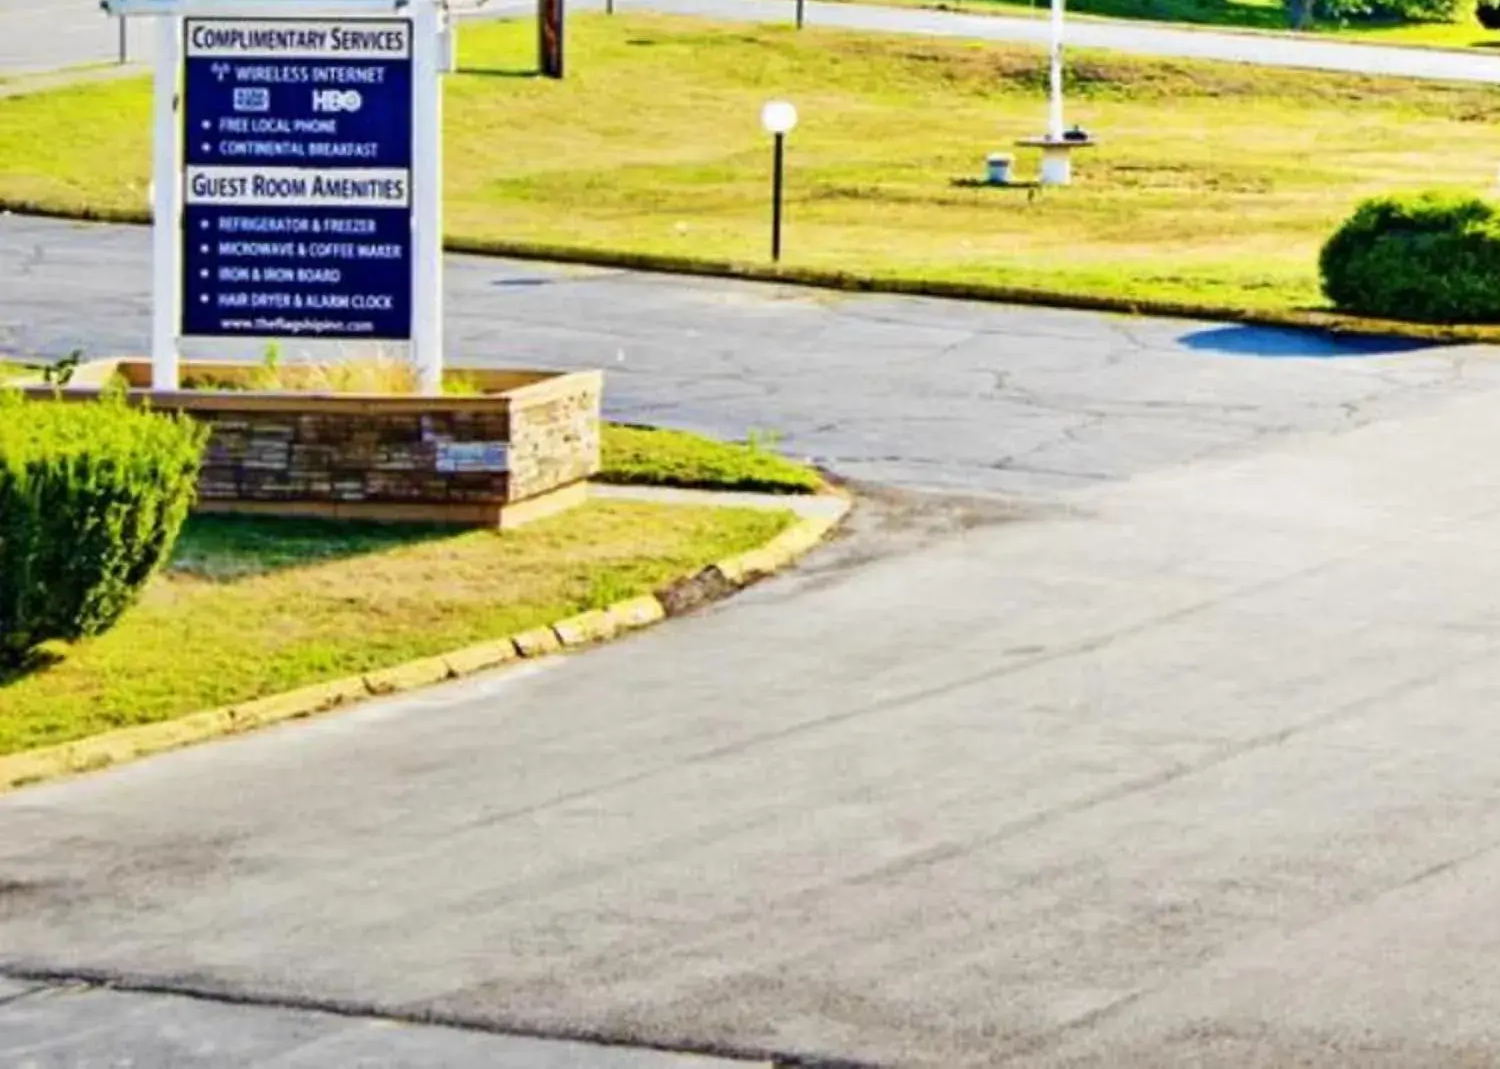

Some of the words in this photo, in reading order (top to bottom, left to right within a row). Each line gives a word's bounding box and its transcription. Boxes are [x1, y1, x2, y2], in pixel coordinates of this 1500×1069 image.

[192, 26, 327, 49] COMPLIMENTARY
[331, 27, 403, 50] SERVICES
[233, 67, 308, 82] WIRELESS
[312, 67, 386, 83] INTERNET
[312, 89, 362, 112] HBO
[219, 119, 248, 132] FREE
[252, 119, 290, 132] LOCAL
[294, 119, 338, 133] PHONE
[219, 141, 305, 155] CONTINENTAL
[308, 142, 379, 157] BREAKFAST
[192, 173, 247, 198] GUEST
[252, 175, 306, 198] ROOM
[310, 175, 404, 199] AMENITIES
[218, 217, 309, 233] REFRIGERATOR
[324, 218, 377, 234] FREEZER
[218, 242, 295, 256] MICROWAVE
[309, 243, 355, 258] COFFEE
[358, 244, 403, 259] MAKER
[219, 267, 250, 281] IRON
[264, 267, 295, 281] IRON
[297, 268, 342, 283] BOARD
[218, 292, 249, 307] HAIR
[251, 293, 291, 308] DRYER
[305, 294, 350, 309] ALARM
[352, 294, 394, 309] CLOCK
